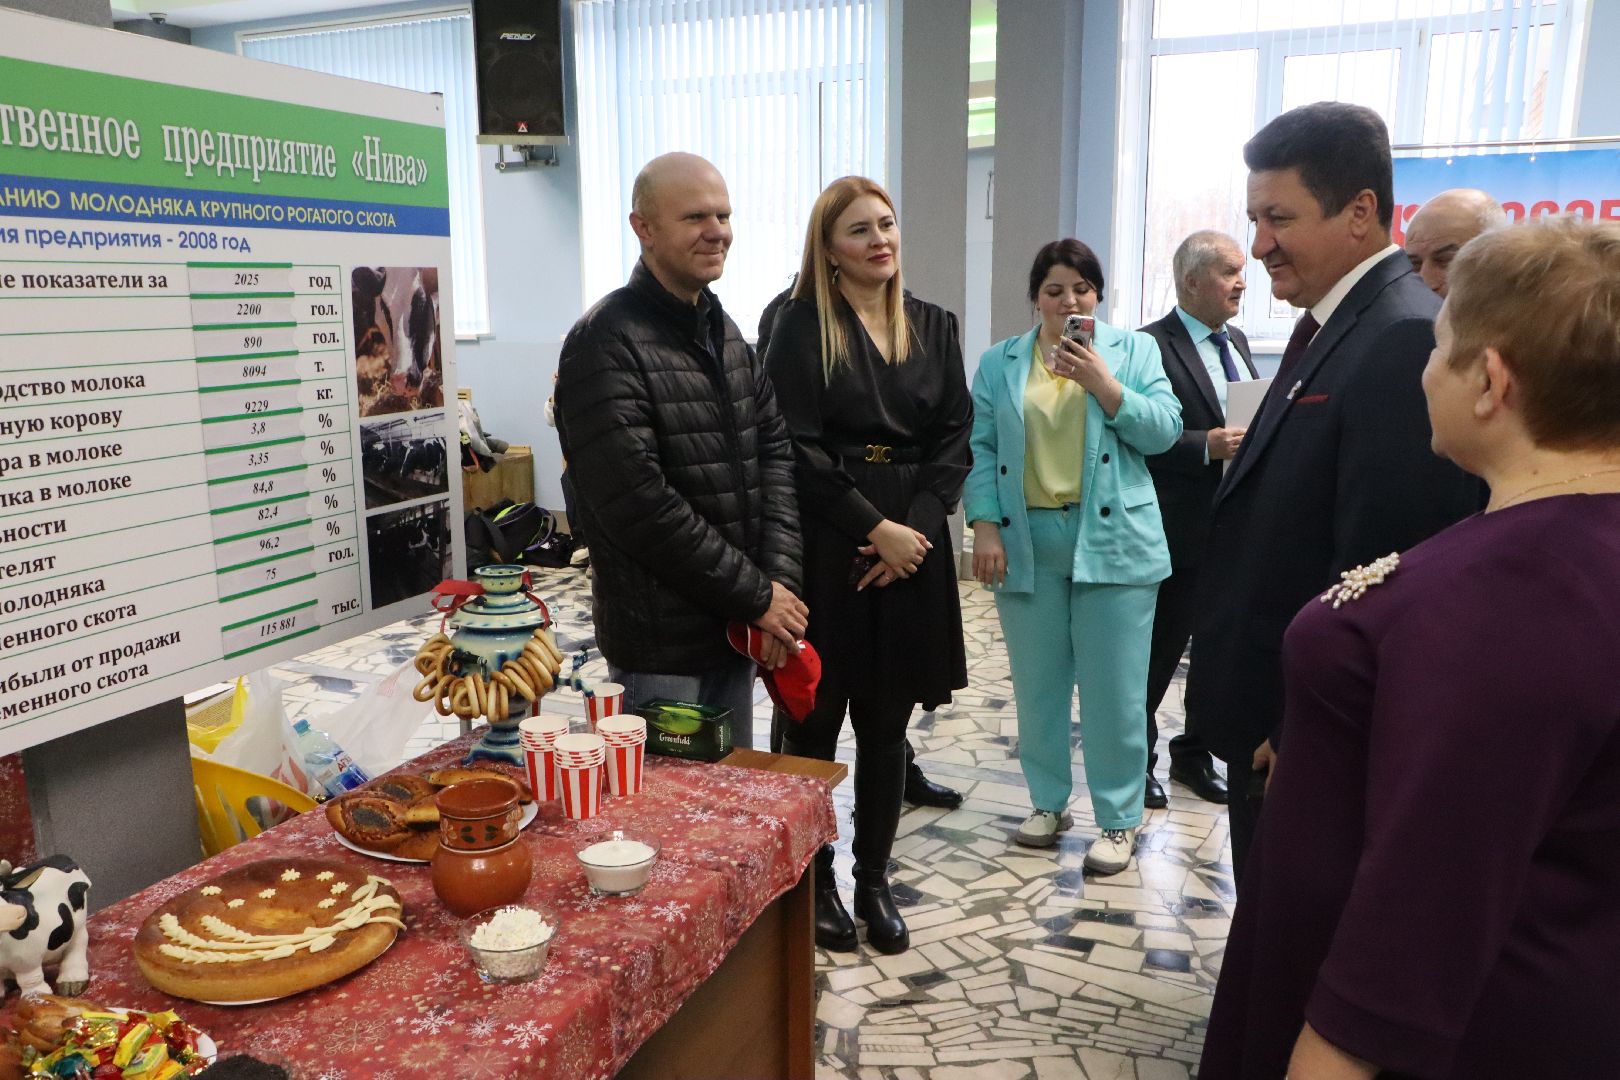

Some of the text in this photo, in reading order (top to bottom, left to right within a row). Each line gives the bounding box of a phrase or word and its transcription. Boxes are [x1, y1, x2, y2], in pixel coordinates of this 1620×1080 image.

[161, 125, 337, 183] предприятие
[351, 135, 428, 187] «Нива»
[70, 192, 198, 217] МОЛОДНЯКА
[201, 200, 284, 222] КРУПНОГО
[287, 206, 354, 226] РОГАТОГО
[356, 210, 397, 228] СКОТА
[25, 229, 162, 250] предприятия
[178, 231, 218, 249] 2008
[222, 236, 251, 253] год
[22, 274, 144, 289] показатели
[148, 276, 168, 288] за
[234, 273, 259, 286] 2025
[308, 276, 333, 290] год
[236, 304, 338, 316] 2200 гол.
[243, 332, 340, 349] 890 гол.
[71, 374, 146, 393] молока
[242, 365, 267, 378] 8094
[314, 361, 325, 373] т.
[0, 388, 334, 439] ную корову 9229 кг.
[29, 454, 41, 468] в
[46, 443, 123, 466] молоке
[250, 421, 266, 435] 3,8
[318, 413, 333, 428] %
[40, 487, 52, 502] в
[57, 475, 132, 499] молоке
[248, 452, 269, 466] 3,35
[320, 440, 335, 456] %
[0, 467, 337, 543] ности 84,8 %
[257, 506, 279, 521] 82,4
[324, 493, 339, 510] %
[0, 520, 341, 616] олодняка 96,2 %
[0, 547, 354, 650] енного скота 75 гол.
[260, 622, 278, 637] 115
[331, 598, 360, 616] тыс.
[71, 655, 94, 674] от
[99, 630, 181, 666] продажи
[0, 663, 149, 720] менного скота
[659, 733, 691, 745] Greenfield
